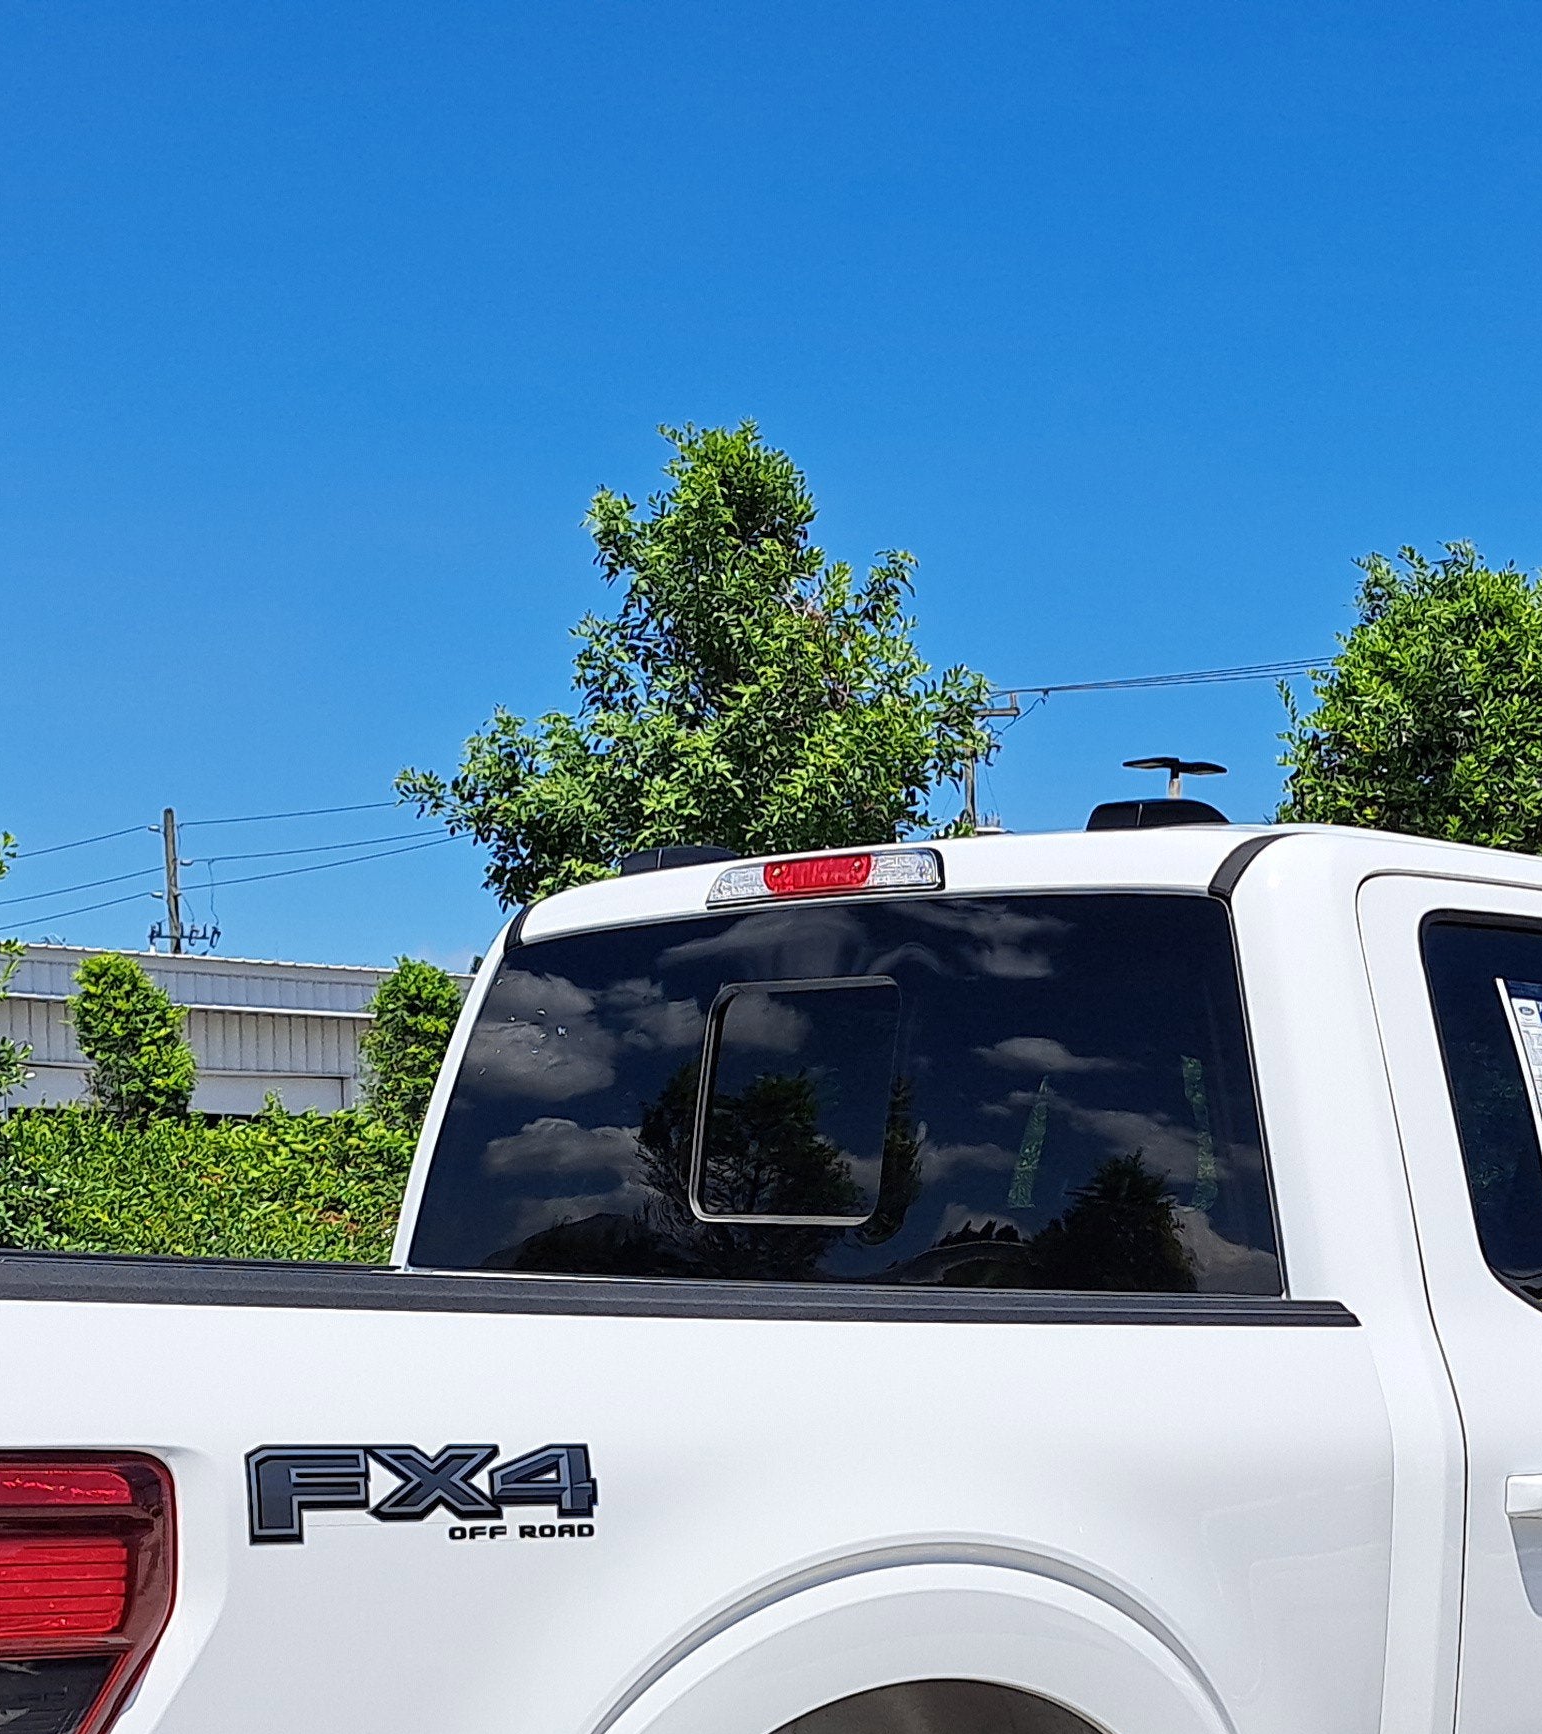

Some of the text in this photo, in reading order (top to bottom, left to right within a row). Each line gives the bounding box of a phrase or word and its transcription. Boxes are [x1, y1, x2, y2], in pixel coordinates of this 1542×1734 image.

[244, 1443, 598, 1545] FX4
[448, 1523, 595, 1541] OFF ROAD
